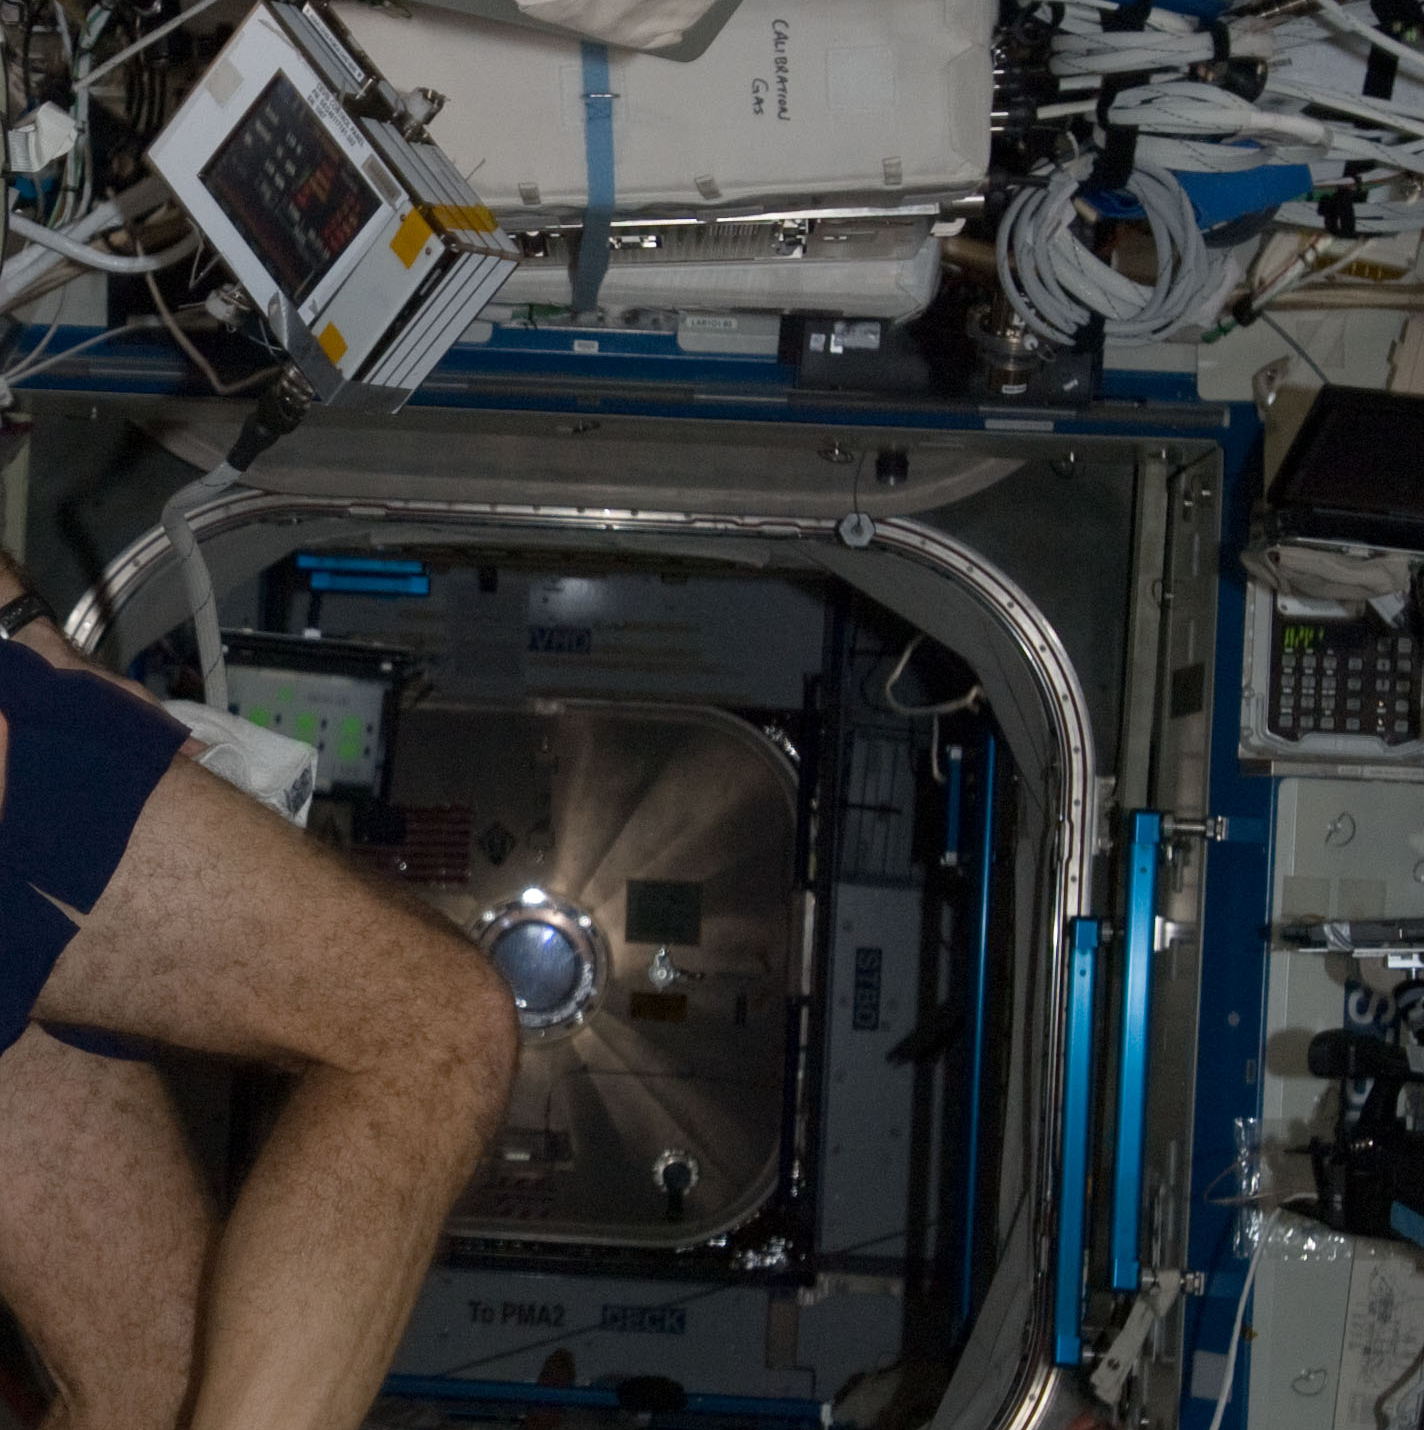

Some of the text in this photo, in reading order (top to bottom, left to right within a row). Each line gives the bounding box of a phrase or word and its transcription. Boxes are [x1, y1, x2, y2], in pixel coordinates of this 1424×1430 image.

[771, 18, 791, 121] CALIBRATION
[348, 126, 367, 147] PANEL
[468, 1301, 566, 1328] To PMA2
